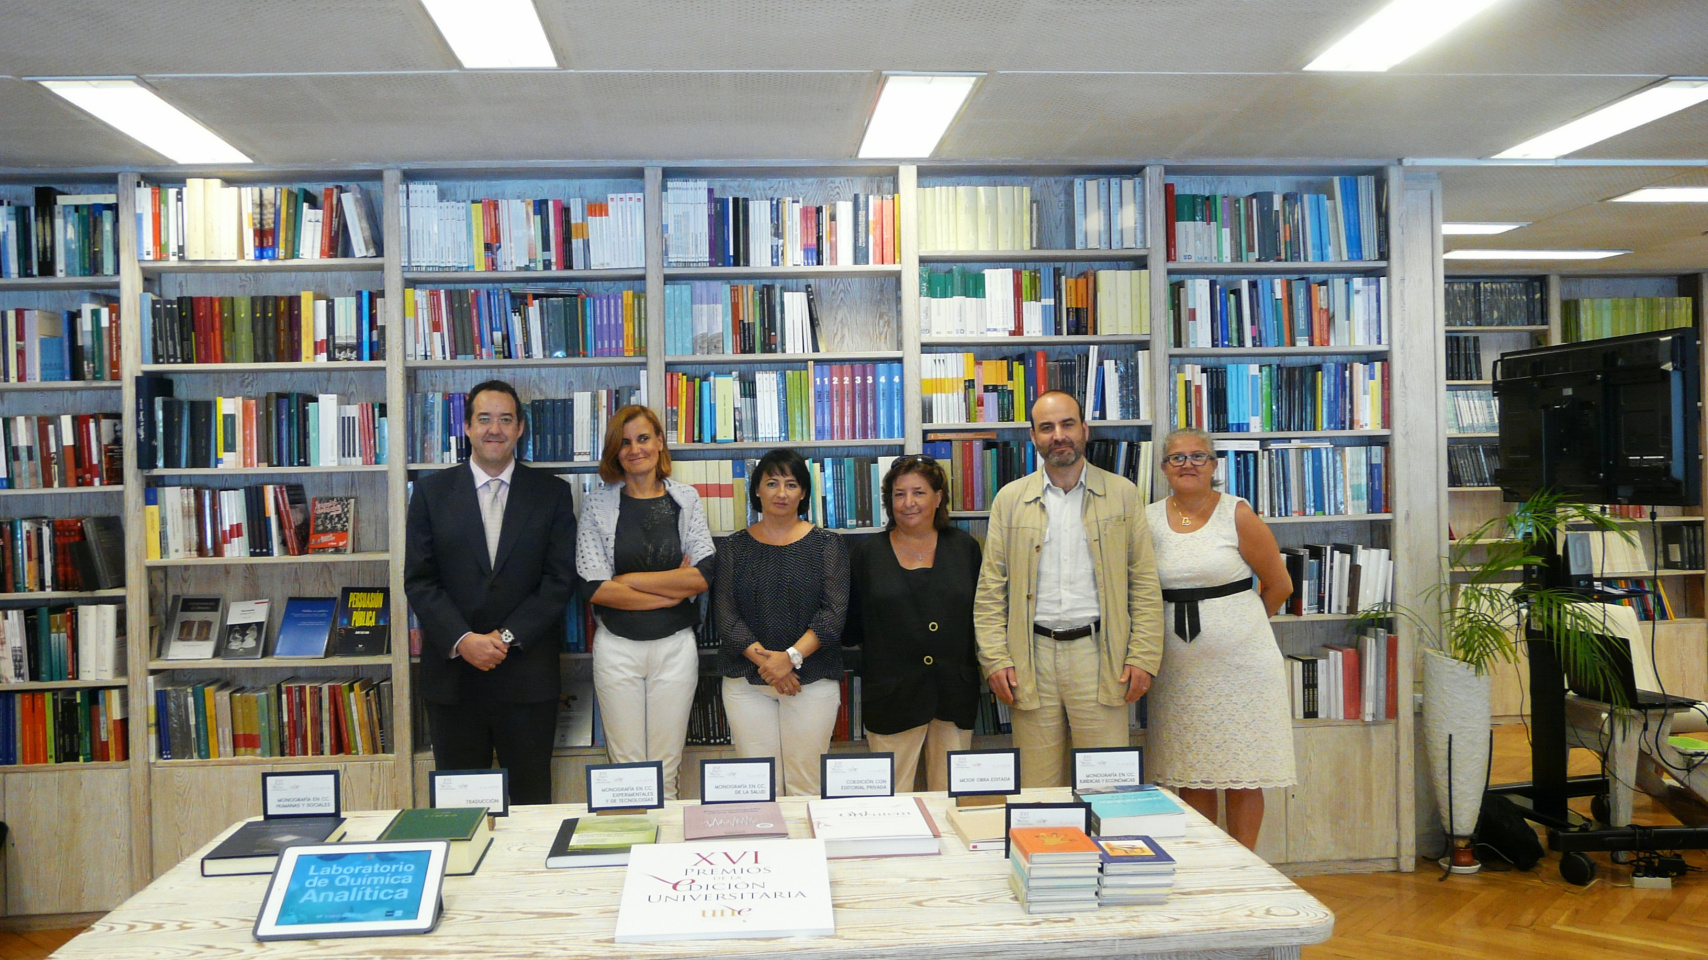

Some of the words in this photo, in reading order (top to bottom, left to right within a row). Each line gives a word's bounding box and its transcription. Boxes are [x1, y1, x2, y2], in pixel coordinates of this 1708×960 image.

[815, 377, 821, 385] 1
[824, 377, 829, 385] 1
[832, 376, 839, 385] 2
[843, 376, 850, 385] 2
[855, 376, 861, 384] 3
[867, 375, 873, 384] 3
[879, 375, 886, 384] 4
[893, 375, 900, 384] 4
[348, 590, 384, 608] PERSUASIÓN
[351, 608, 376, 627] PÚBLICA
[692, 850, 761, 867] XVI
[308, 861, 415, 876] Laboratorio
[684, 866, 772, 876] PREMIOS
[304, 876, 329, 888] de
[334, 873, 413, 887] Química
[299, 887, 409, 904] Analítica
[647, 890, 807, 903] UNIVERSITARIA
